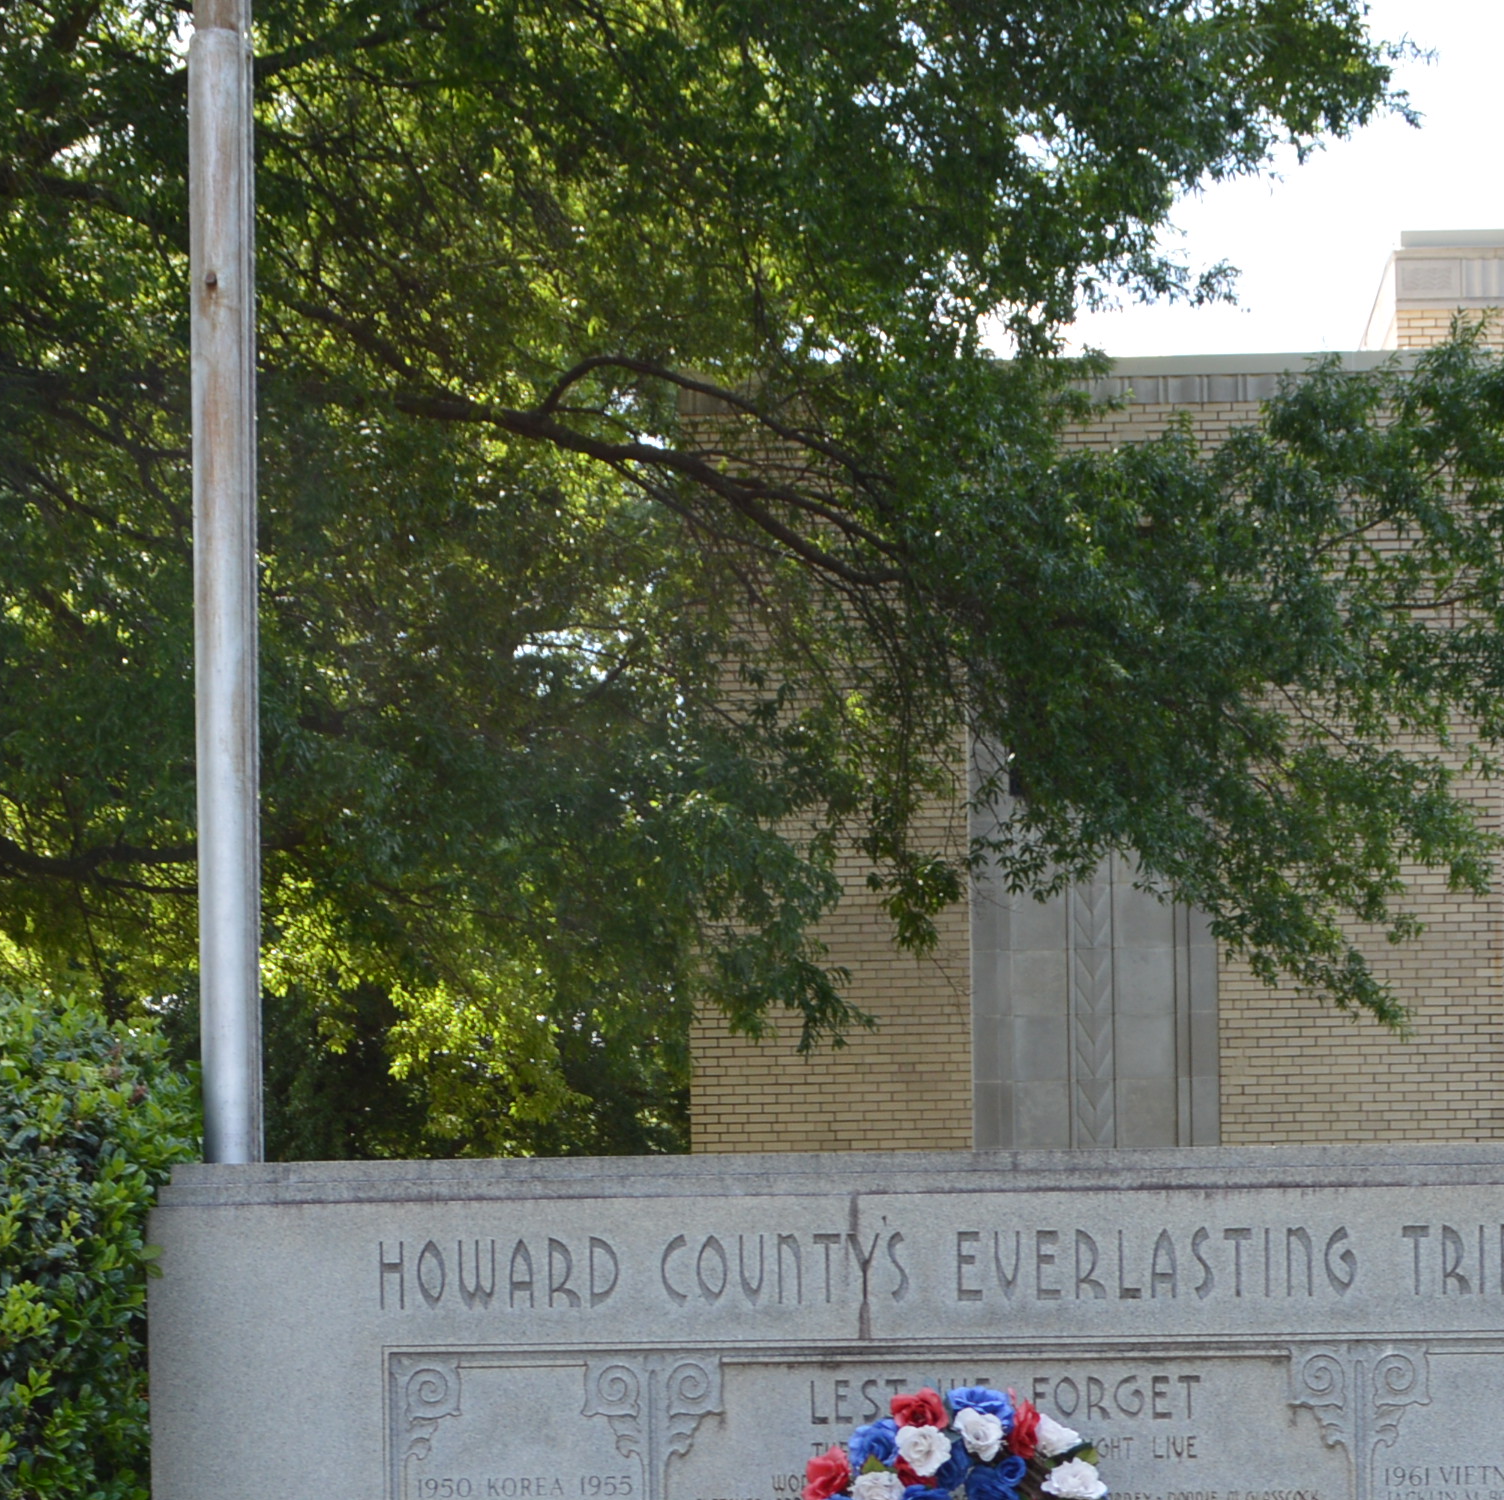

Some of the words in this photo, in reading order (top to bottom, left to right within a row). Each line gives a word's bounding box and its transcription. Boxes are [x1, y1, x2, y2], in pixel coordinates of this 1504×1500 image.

[379, 1234, 619, 1310] HOWARD
[661, 1215, 909, 1306] COUNTY'S
[956, 1226, 1358, 1300] EVERLASTING
[810, 1378, 908, 1425] LEST
[1033, 1375, 1201, 1420] FORGET
[1153, 1436, 1198, 1459] LIVE
[418, 1478, 472, 1498] 1950
[488, 1477, 565, 1497] KOREA
[581, 1476, 633, 1496] 1955
[1386, 1466, 1429, 1486] 1961
